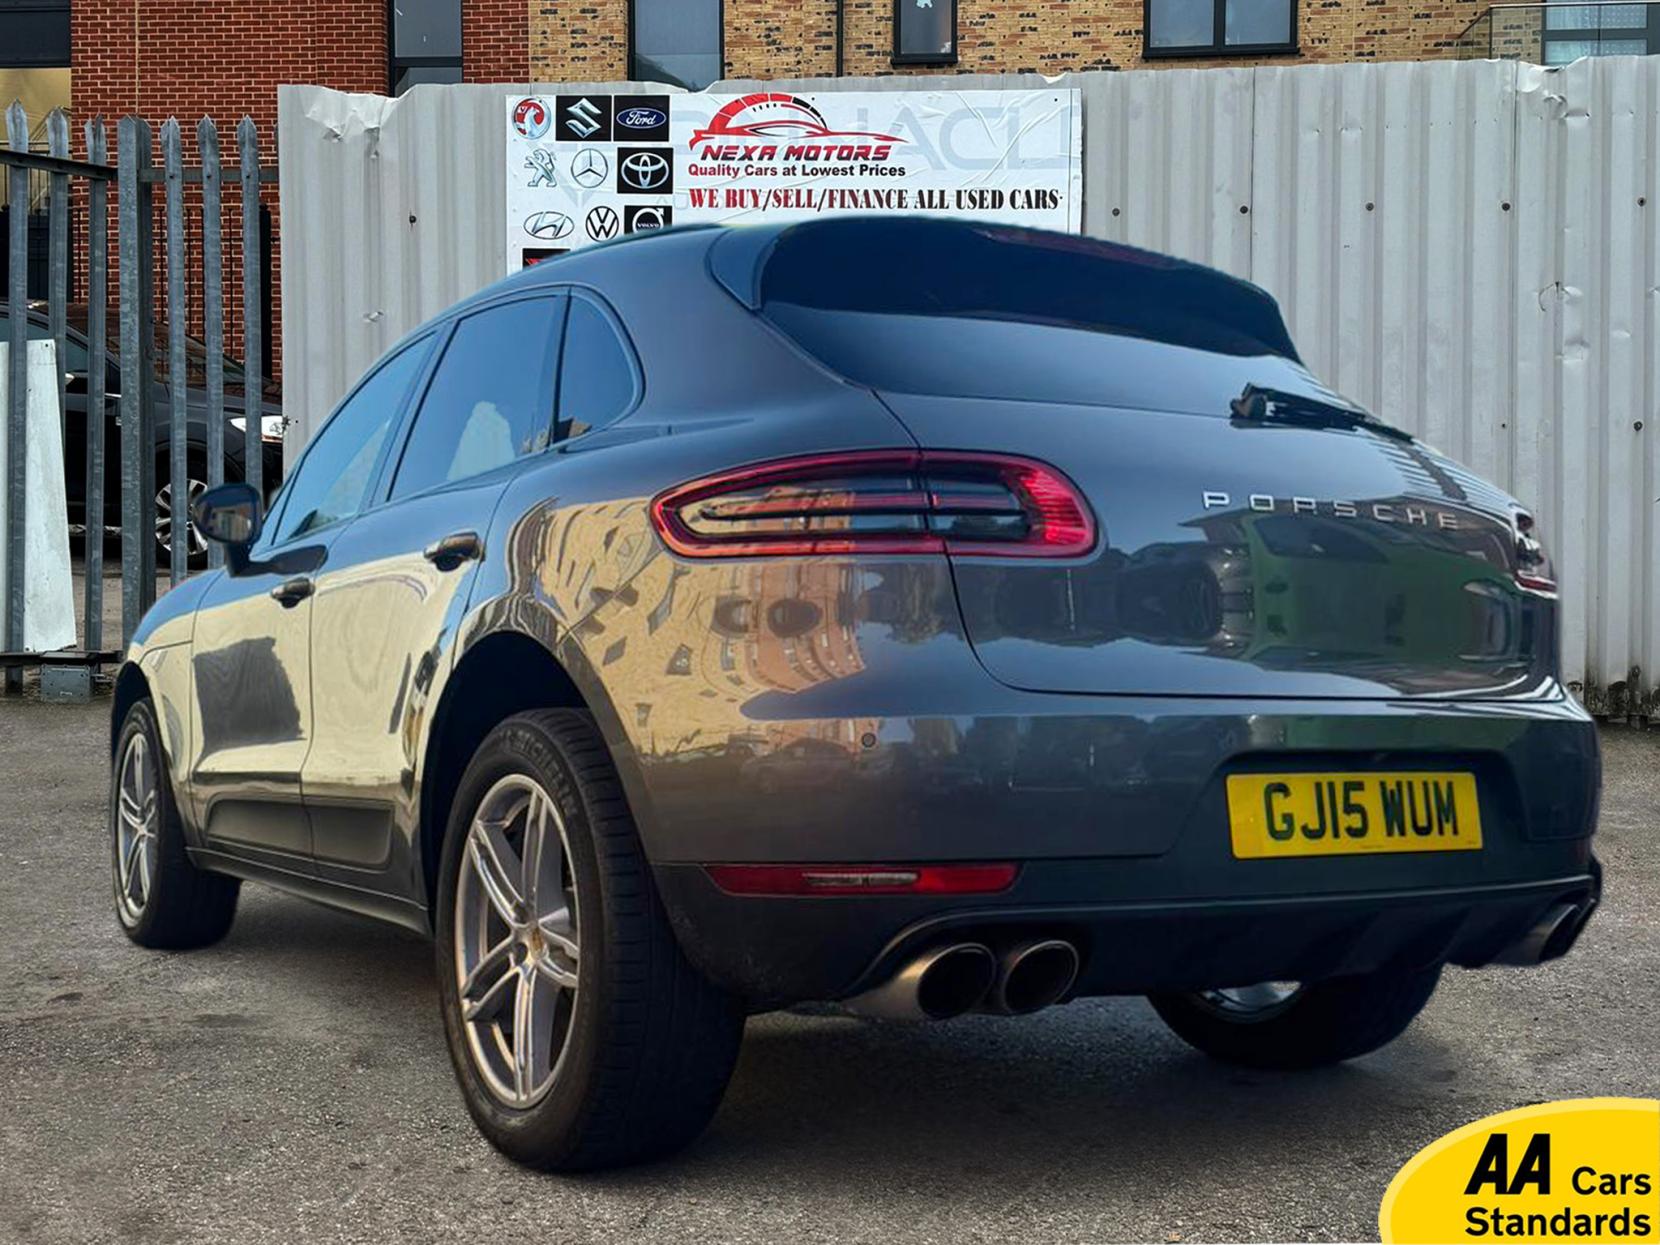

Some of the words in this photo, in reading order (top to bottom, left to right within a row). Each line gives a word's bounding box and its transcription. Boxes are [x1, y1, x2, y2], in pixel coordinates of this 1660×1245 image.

[626, 111, 656, 125] Ford
[700, 144, 778, 161] NEXA
[783, 144, 892, 161] MOTORS
[688, 163, 740, 179] Quality
[744, 164, 778, 176] Cars
[782, 165, 797, 176] at
[801, 164, 855, 176] Lowest
[859, 164, 906, 177] Prices
[687, 188, 719, 209] WE
[725, 187, 908, 212] BUY/SELL/FINANCE
[914, 189, 950, 210] ALL
[955, 189, 1004, 210] USED
[1202, 491, 1458, 531] PORSCHE
[1263, 781, 1370, 841] GJ15
[1379, 779, 1460, 838] WUM
